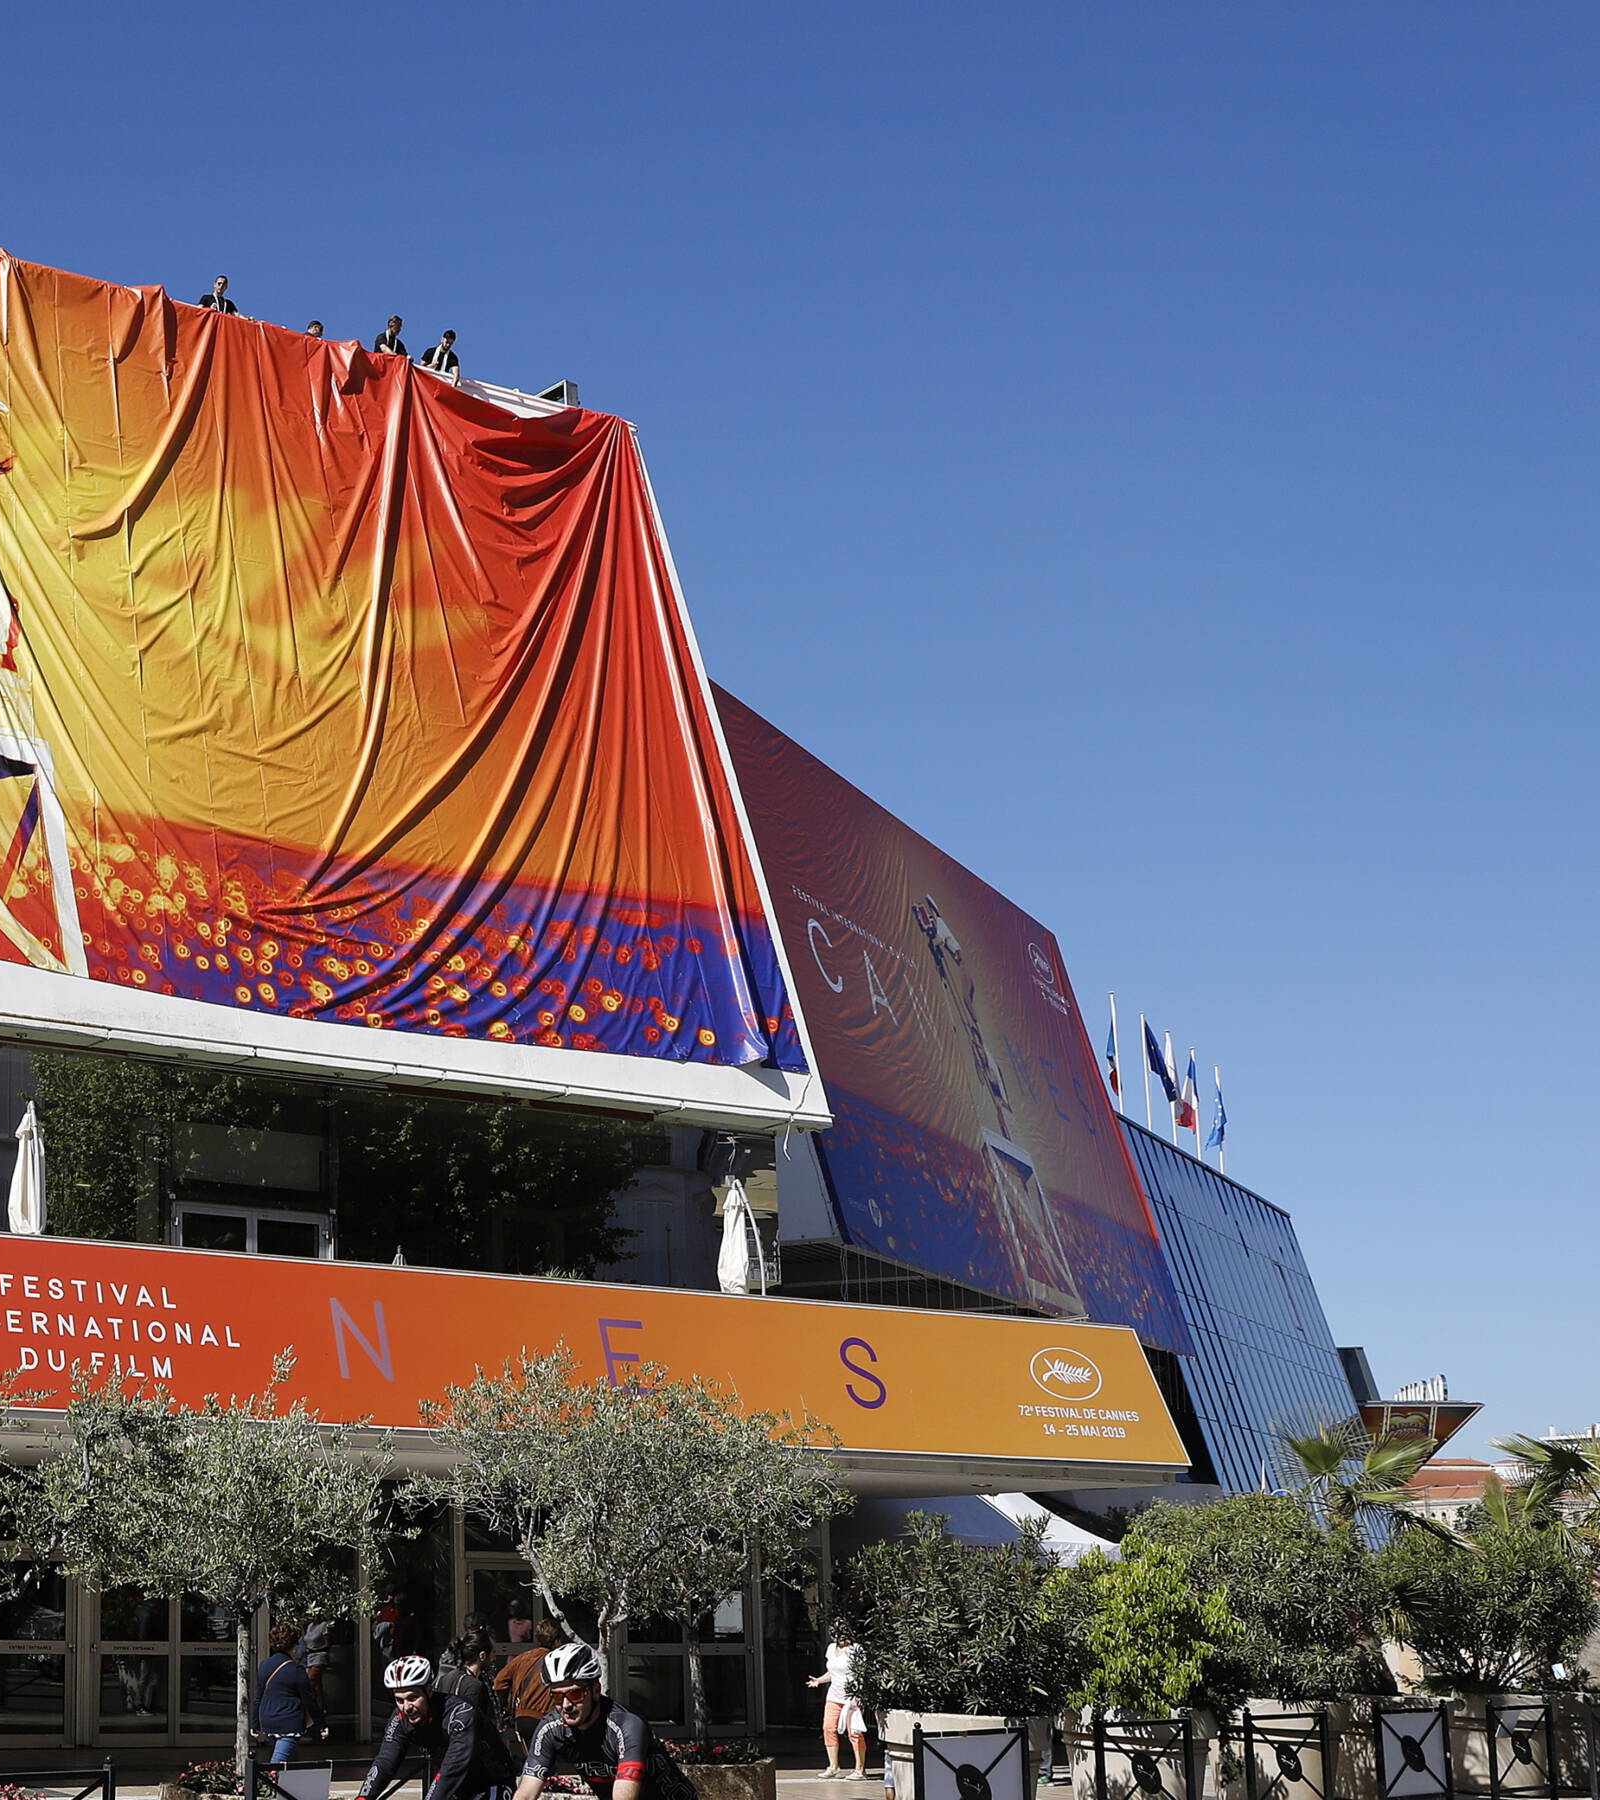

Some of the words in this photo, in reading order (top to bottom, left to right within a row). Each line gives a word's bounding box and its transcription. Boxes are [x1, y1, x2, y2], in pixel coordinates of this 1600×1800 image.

[0, 1273, 178, 1310] FESTIVAL
[20, 1346, 66, 1372] DU
[91, 1352, 174, 1379] FILM
[1034, 1406, 1083, 1419] FESTIVAL
[1082, 1408, 1098, 1420] DE
[1098, 1409, 1140, 1422] CANNES
[1043, 1423, 1056, 1435] 14
[1065, 1424, 1079, 1436] 25
[1080, 1425, 1101, 1437] MAI
[1101, 1426, 1126, 1438] 2019
